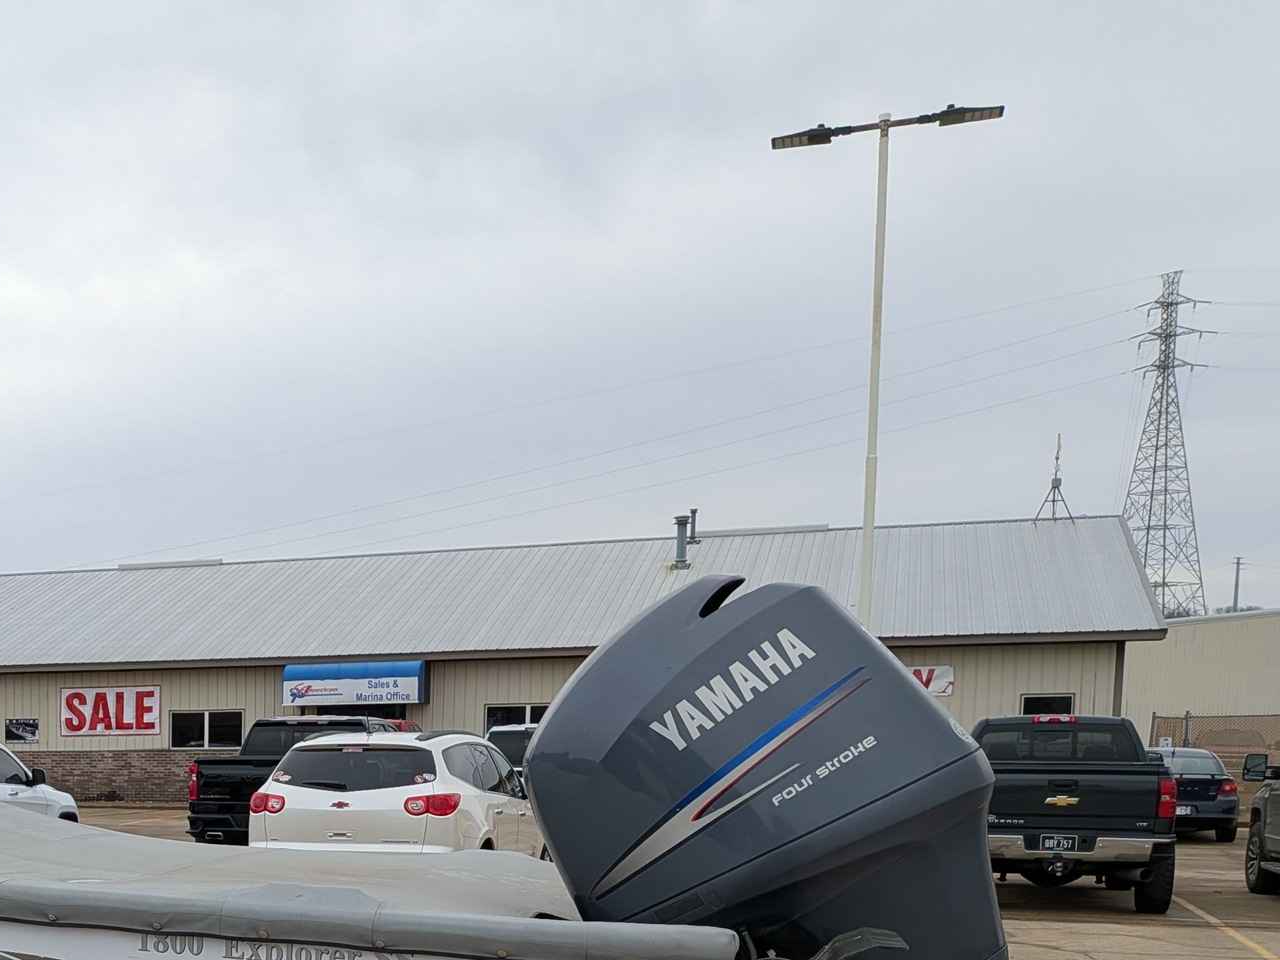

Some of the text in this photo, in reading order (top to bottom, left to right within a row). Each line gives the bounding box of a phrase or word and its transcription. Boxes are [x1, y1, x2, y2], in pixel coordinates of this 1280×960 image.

[367, 680, 399, 689] Sales &
[649, 628, 816, 751] YAMAHA
[356, 692, 411, 702] Marina Office
[65, 691, 156, 732] SALE
[138, 933, 204, 957] 1800
